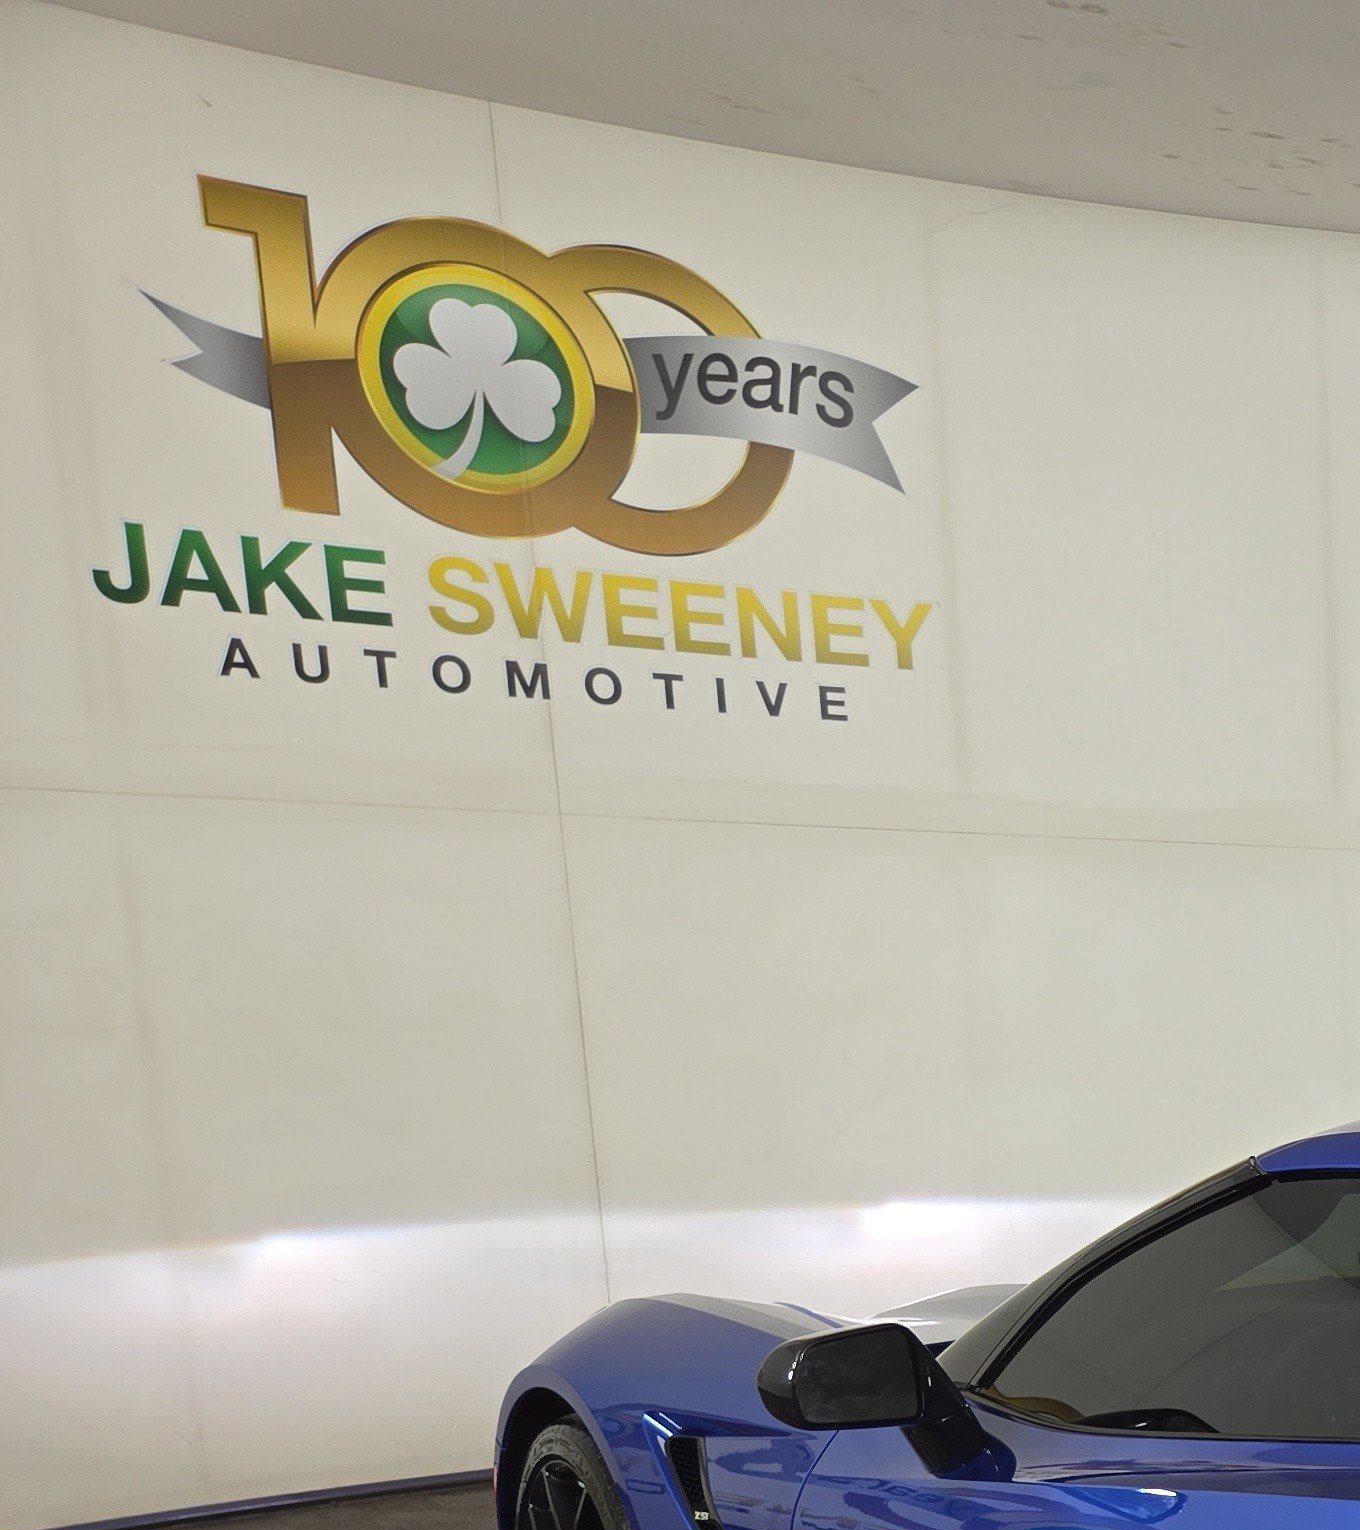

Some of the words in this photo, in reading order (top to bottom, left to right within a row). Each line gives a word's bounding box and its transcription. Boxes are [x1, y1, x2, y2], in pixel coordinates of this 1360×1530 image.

[196, 174, 795, 555] 100
[651, 347, 857, 428] years
[92, 519, 393, 627] JAKE
[427, 555, 933, 671] SWEENEY
[221, 636, 850, 723] AUTOMOTIVE
